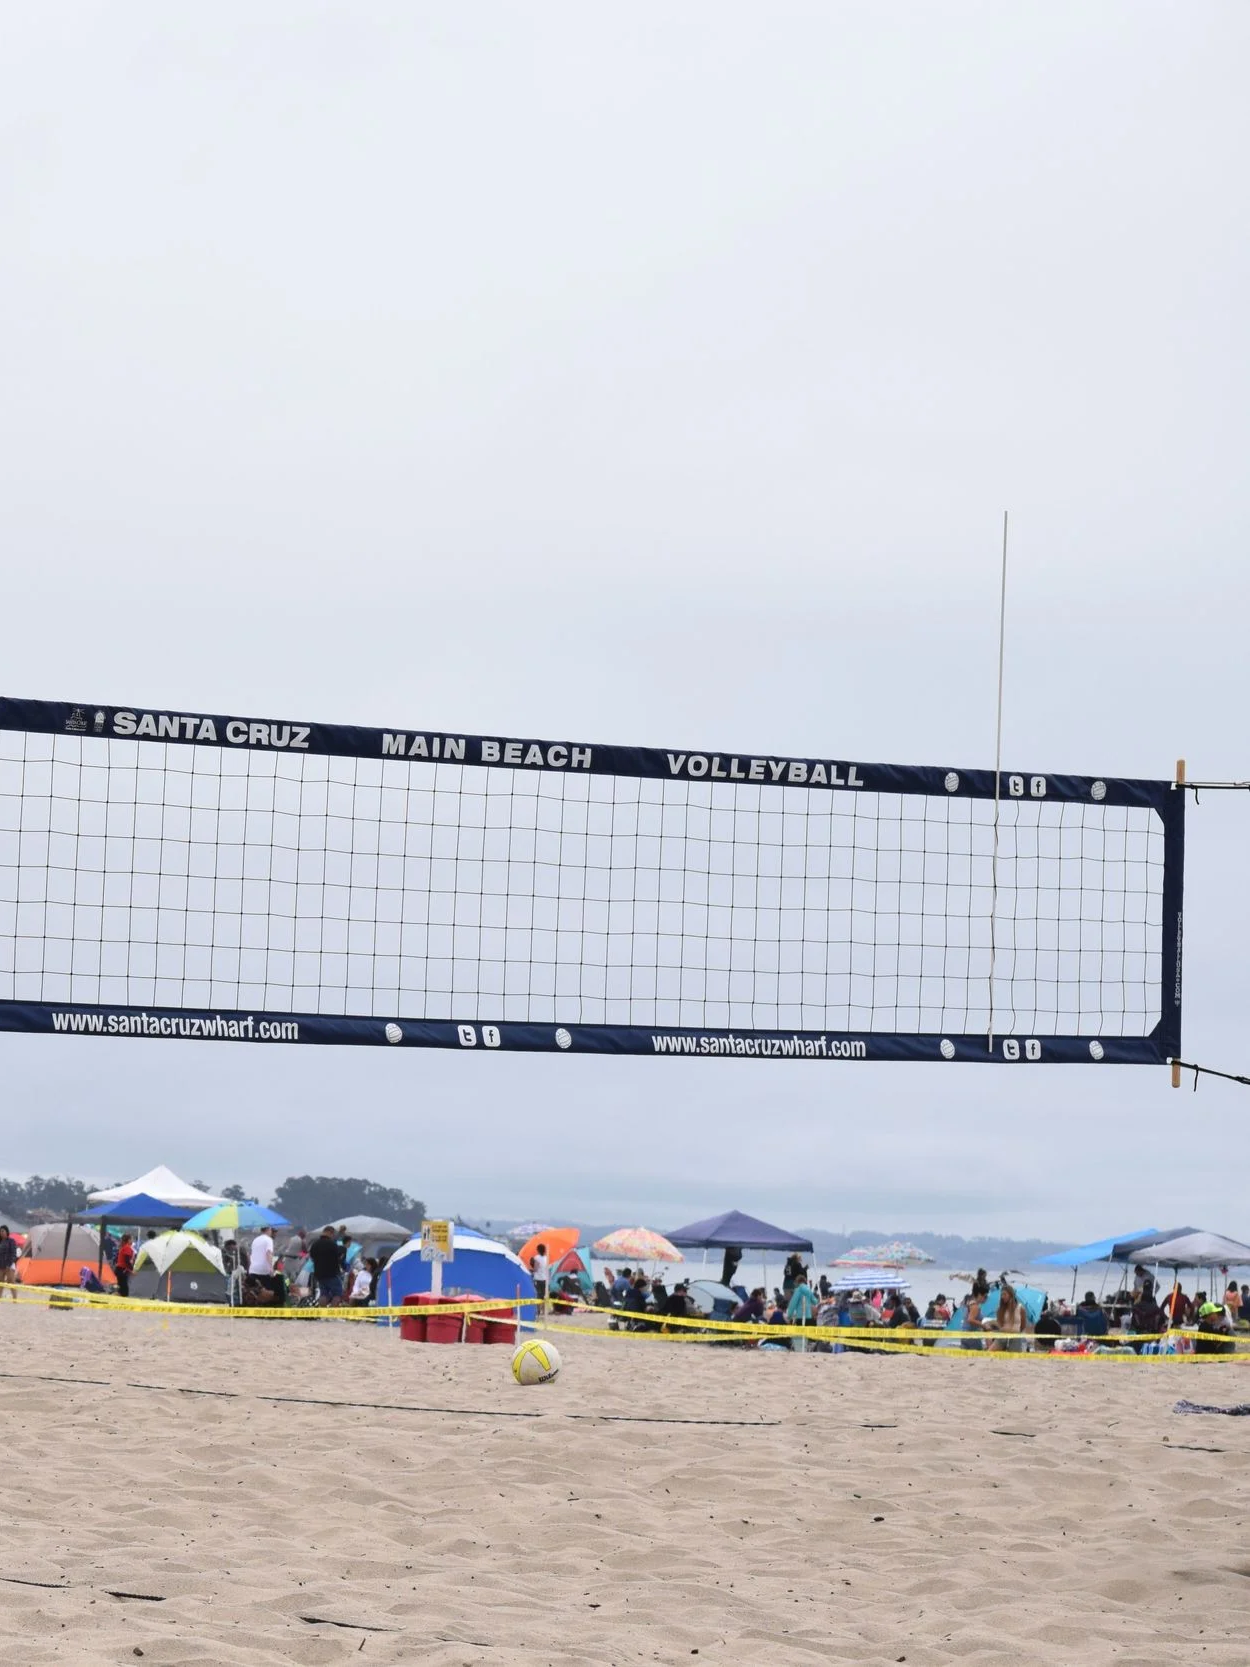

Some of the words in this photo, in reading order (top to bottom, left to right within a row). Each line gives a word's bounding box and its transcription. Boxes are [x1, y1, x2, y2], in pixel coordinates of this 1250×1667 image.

[112, 710, 218, 741] SANTA
[225, 719, 311, 749] CRUZ
[381, 733, 467, 761] MAIN
[480, 741, 593, 769] BEACH
[666, 753, 865, 788] VOLLEYBALL
[52, 1012, 300, 1041] www.santacruzwharf.com
[651, 1034, 867, 1058] www.santacruzwharf.com
